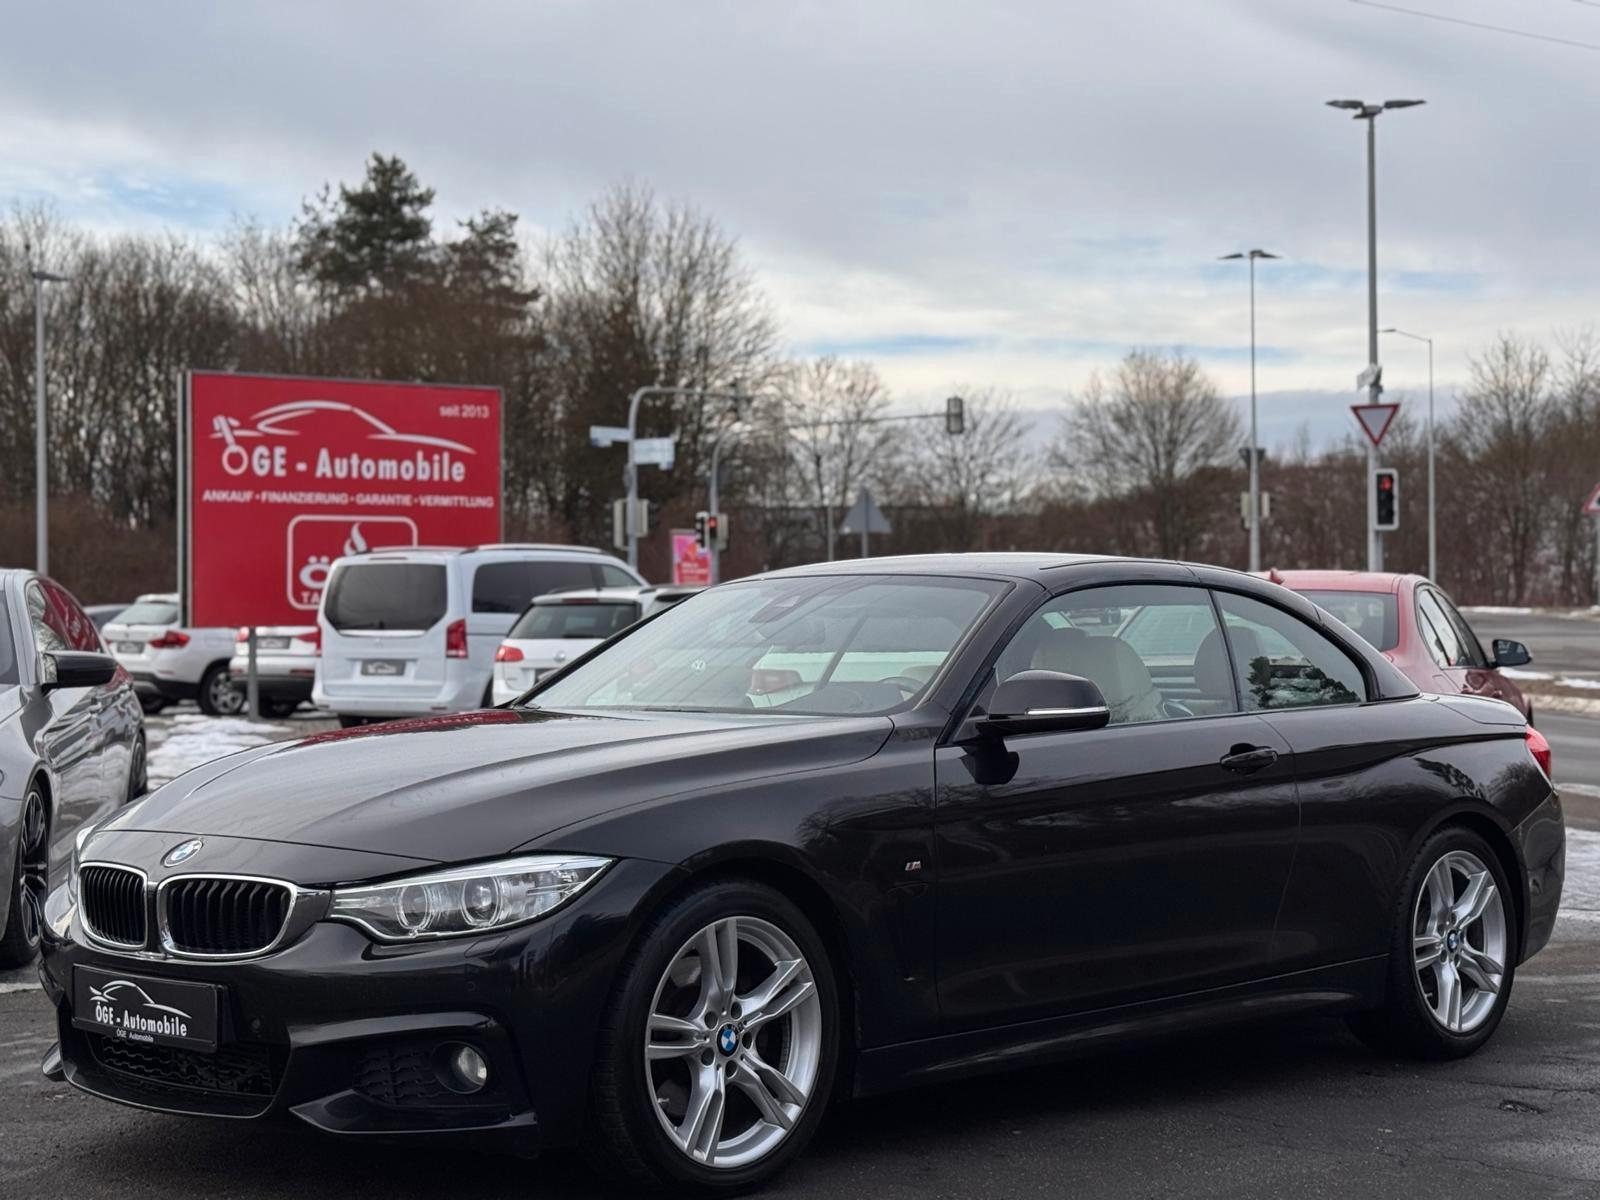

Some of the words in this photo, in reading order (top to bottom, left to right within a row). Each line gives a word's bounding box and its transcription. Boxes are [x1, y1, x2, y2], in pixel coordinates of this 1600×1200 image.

[462, 404, 489, 418] 2013
[315, 447, 466, 482] Automobile
[202, 490, 254, 503] ANKAUF
[260, 491, 348, 505] FINANZIERUNG
[356, 493, 413, 506] GARANTIE
[419, 495, 494, 508] VERMITTLUNG
[123, 1009, 188, 1037] Automobile
